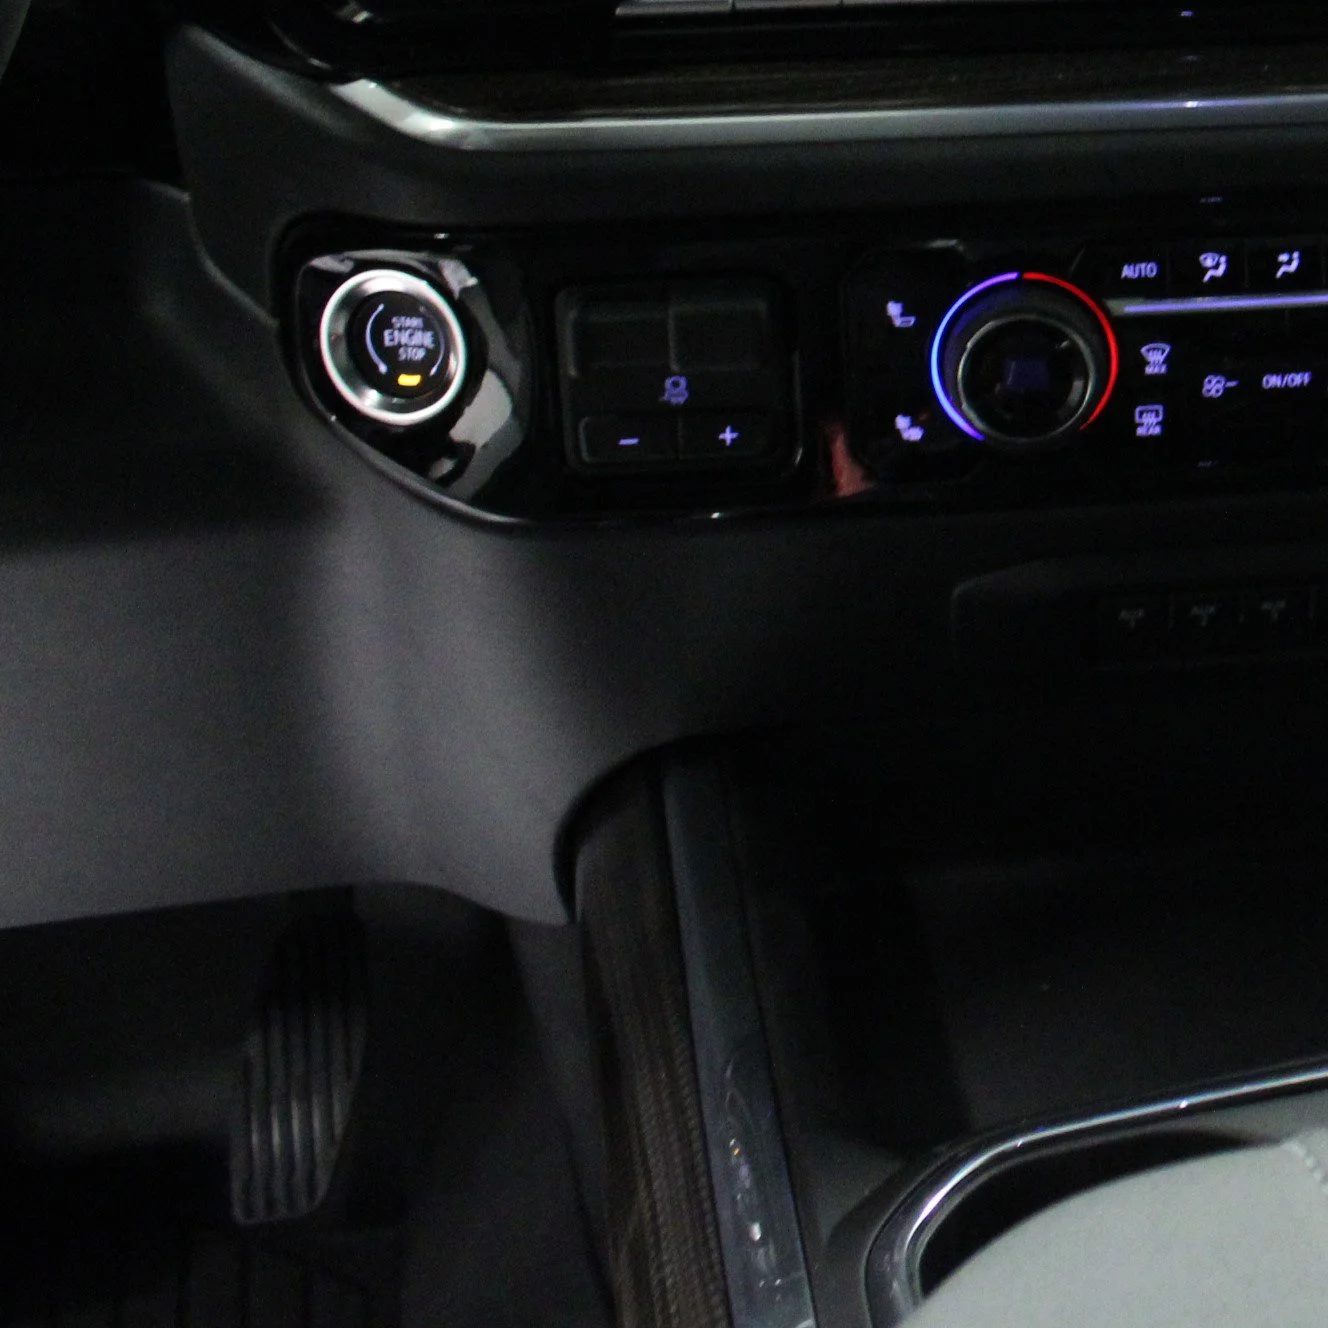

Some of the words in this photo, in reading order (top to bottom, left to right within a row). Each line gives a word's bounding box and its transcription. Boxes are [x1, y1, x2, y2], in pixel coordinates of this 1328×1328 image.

[1121, 262, 1158, 279] AUTO
[383, 329, 435, 349] ENGINE
[1261, 371, 1312, 389] ON/OFF
